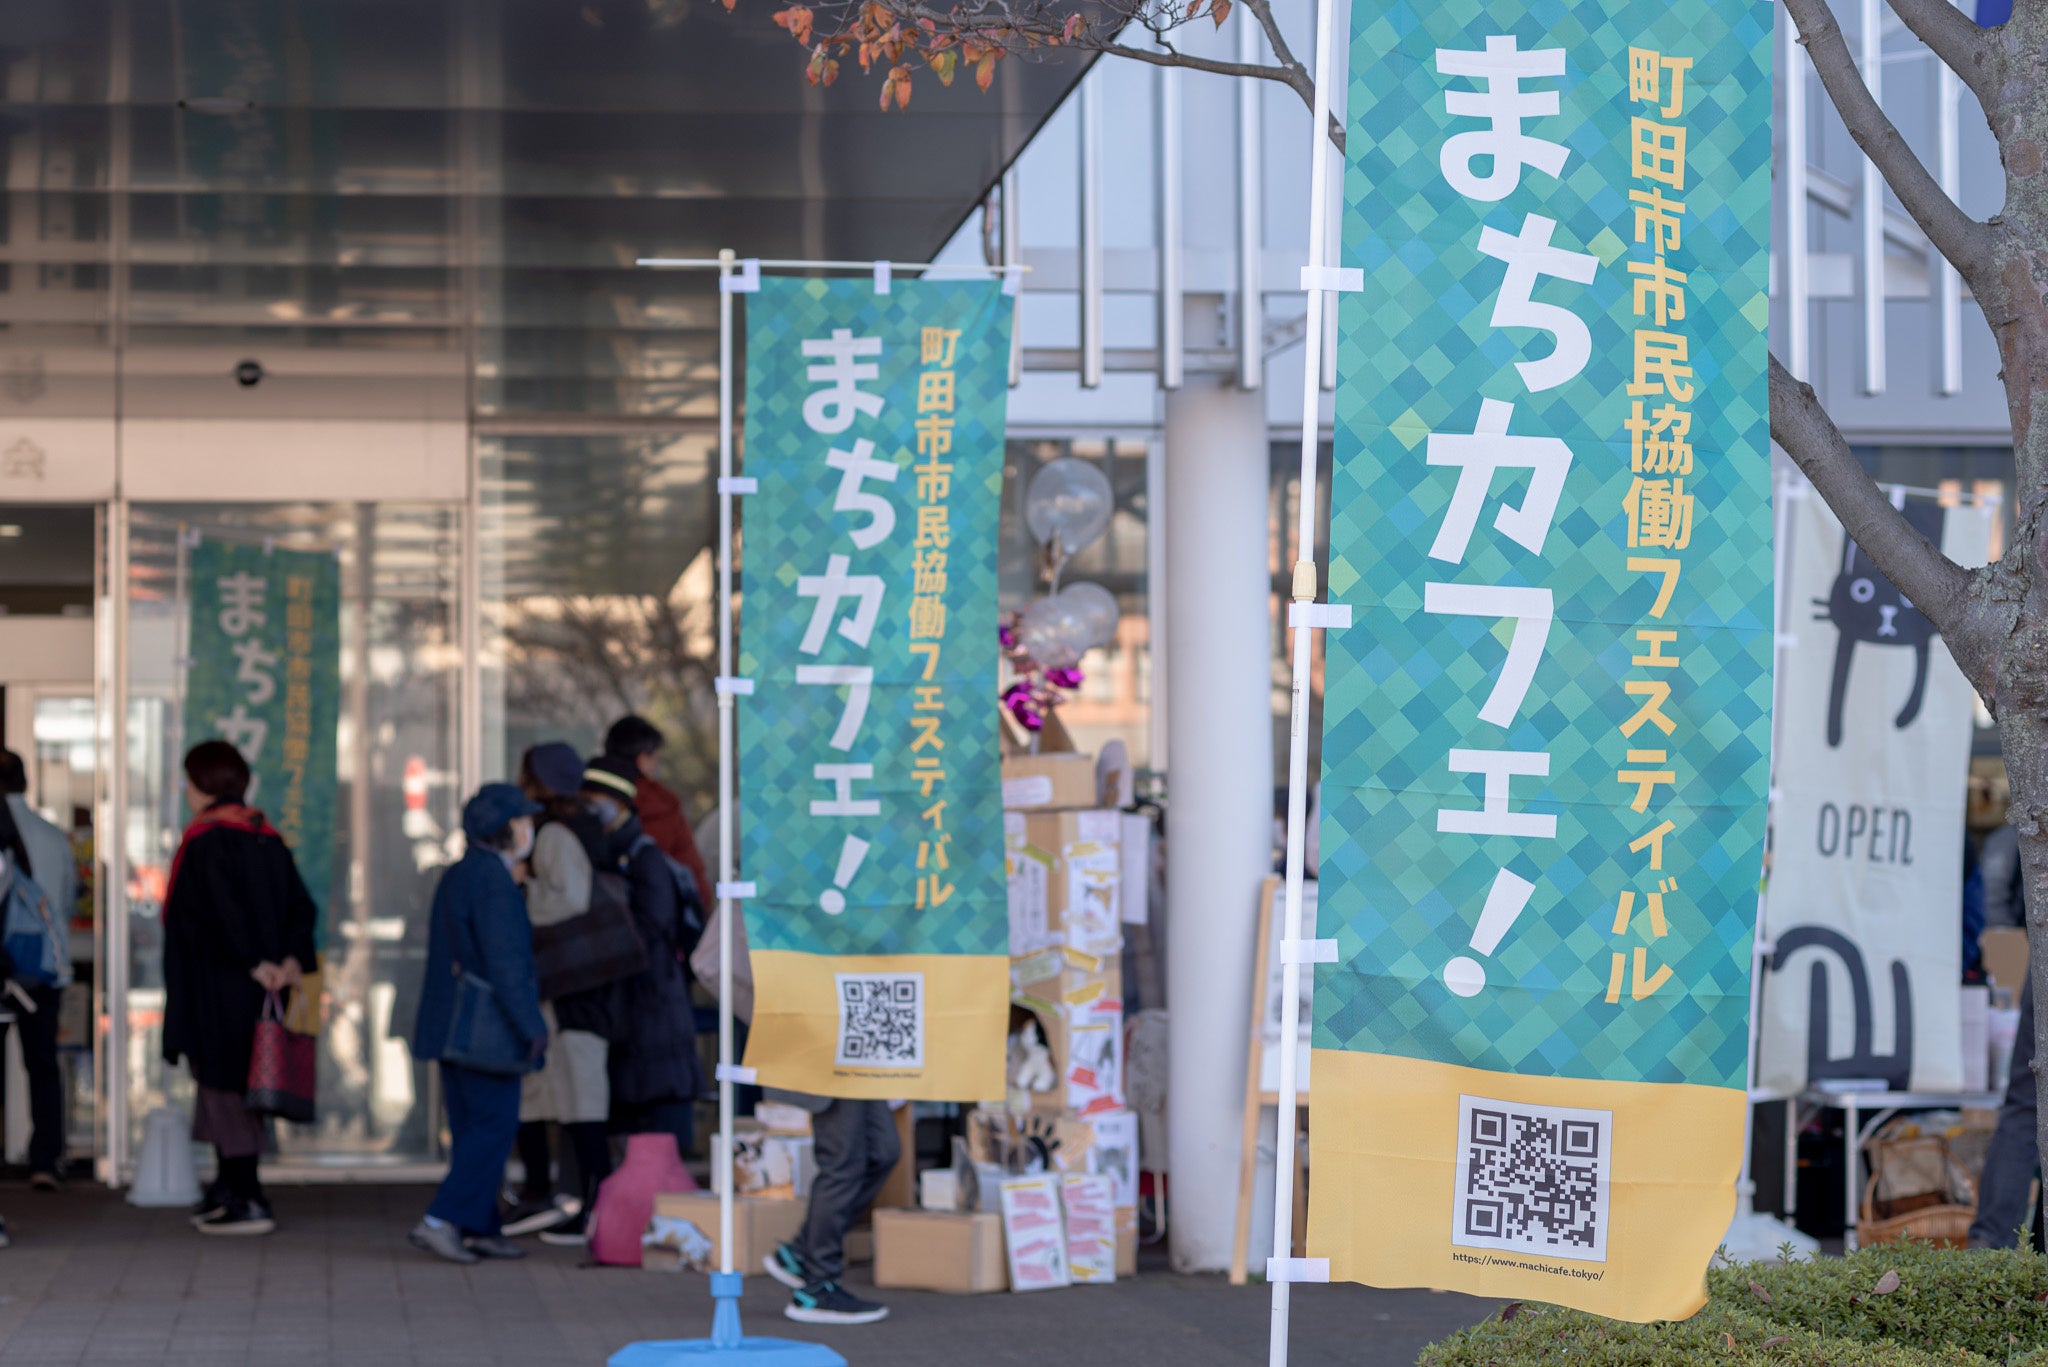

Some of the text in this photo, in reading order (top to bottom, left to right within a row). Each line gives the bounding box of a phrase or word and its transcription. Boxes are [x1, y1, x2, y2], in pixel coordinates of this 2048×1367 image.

[908, 326, 962, 910] 町田市市民協働フェスティバル
[1605, 47, 1694, 1004] 町田市市民協働フェスティバル
[1817, 801, 1914, 865] OPEN
[1452, 1252, 1605, 1282] https://www.machicafe.tokyo/
